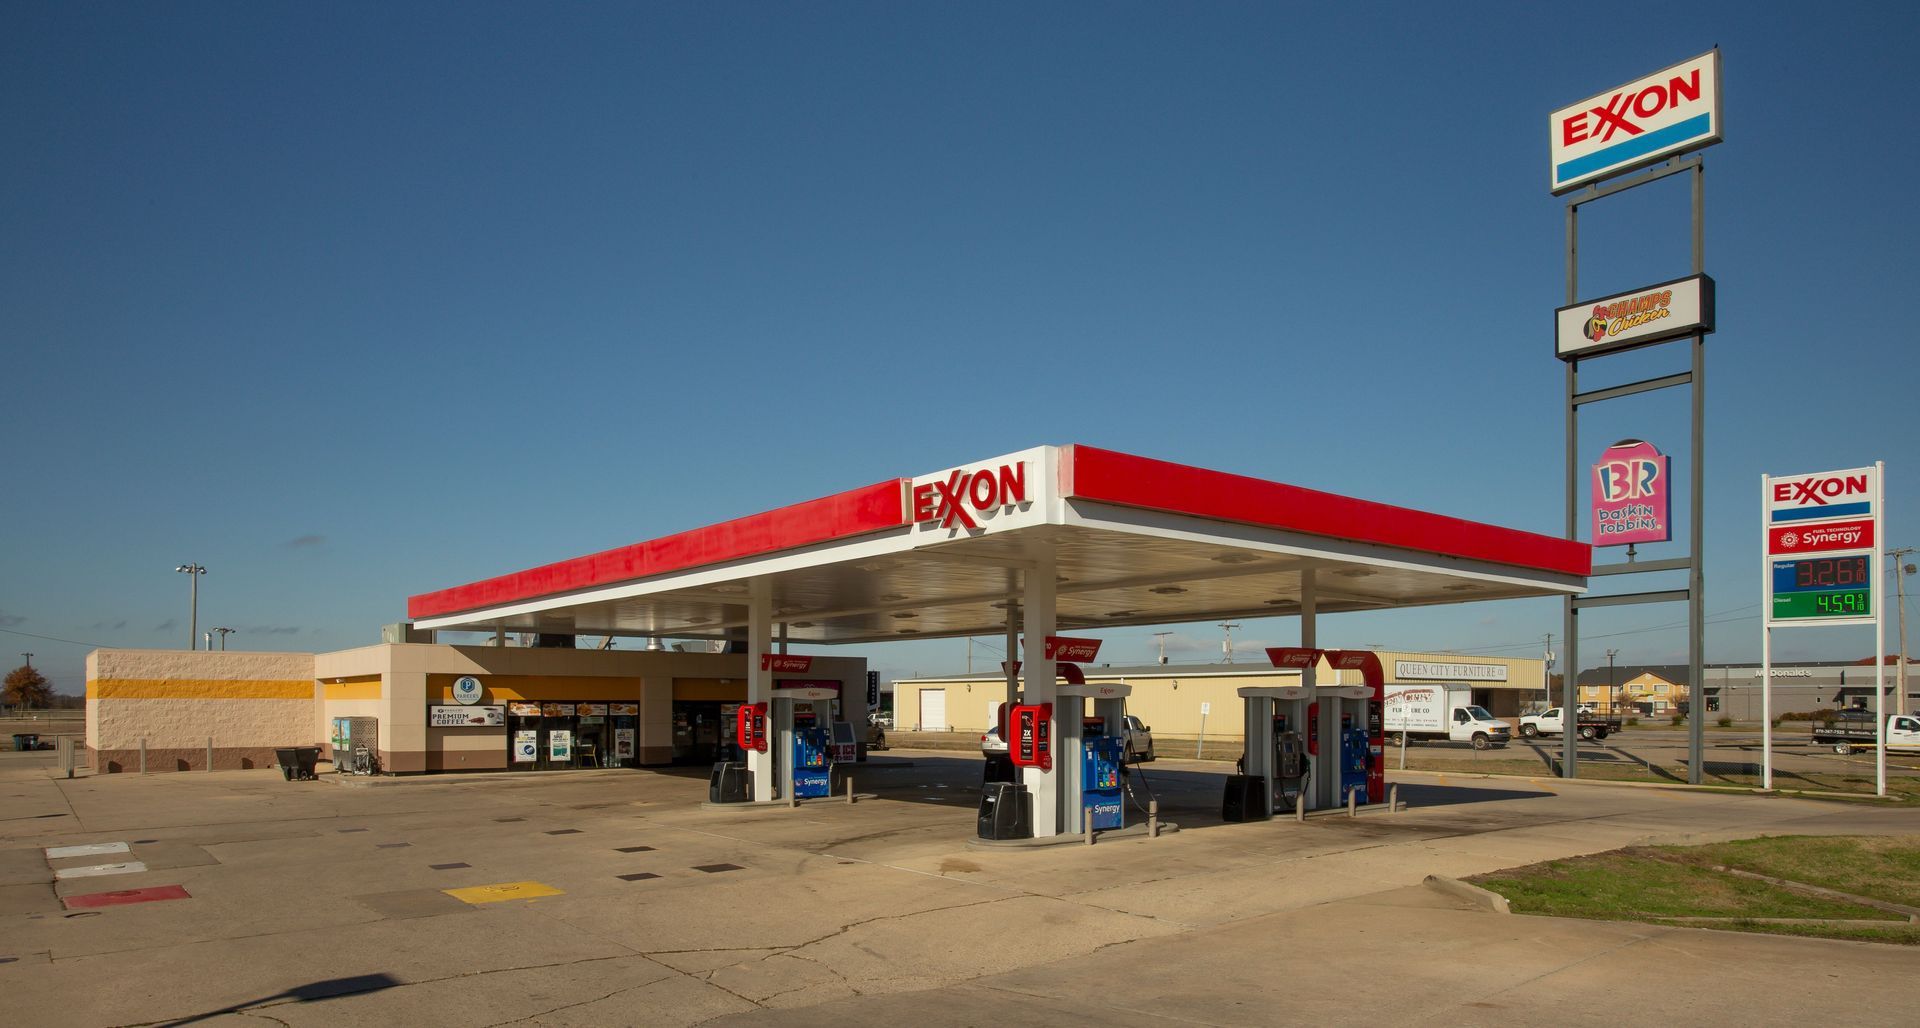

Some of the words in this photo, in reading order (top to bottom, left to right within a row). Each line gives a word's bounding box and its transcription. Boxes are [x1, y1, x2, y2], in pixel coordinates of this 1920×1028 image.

[1563, 68, 1700, 147] EXXON
[1608, 289, 1672, 319] CHAMPS
[1608, 307, 1671, 337] Chicken
[914, 461, 1025, 529] EXXON
[1774, 474, 1867, 505] EXXON
[1598, 504, 1653, 521] baskin
[1600, 517, 1657, 535] robbins
[1803, 531, 1862, 546] Synergy
[1068, 646, 1096, 657] Synergy
[1400, 663, 1428, 676] QUEEN
[1430, 664, 1450, 676] CITY
[1453, 665, 1496, 677] FURNITURE
[1023, 729, 1032, 737] 2X
[804, 778, 828, 787] Synergy
[1094, 804, 1121, 815] Synergy
